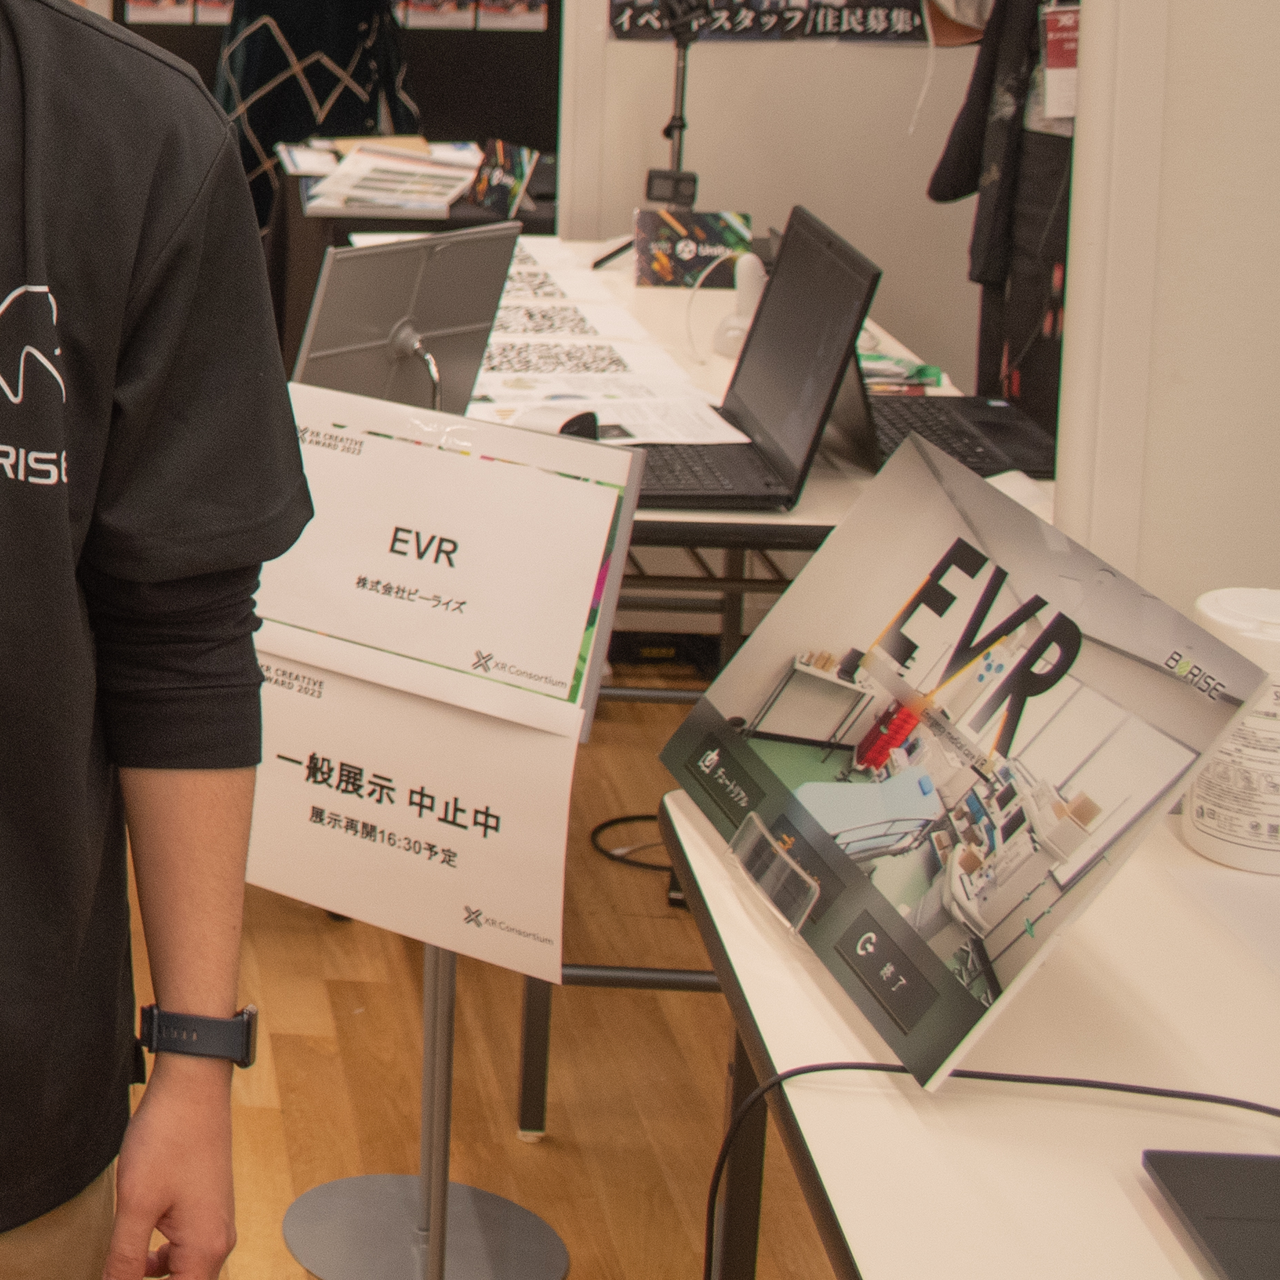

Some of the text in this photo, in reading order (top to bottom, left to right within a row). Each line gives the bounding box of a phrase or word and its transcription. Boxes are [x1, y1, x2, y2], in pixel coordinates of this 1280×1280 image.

[308, 437, 362, 456] AWARD 2023
[310, 430, 364, 448] XR CREATIVE
[389, 526, 459, 568] EVR
[861, 536, 1083, 760] EVR
[262, 672, 323, 699] WARD 2023
[273, 666, 325, 690] CREATIVE
[508, 664, 568, 689] Consortium
[276, 753, 501, 839] 一般展示 中止中
[309, 806, 459, 868] 展示再開16:30予定
[498, 921, 554, 946] Consortium
